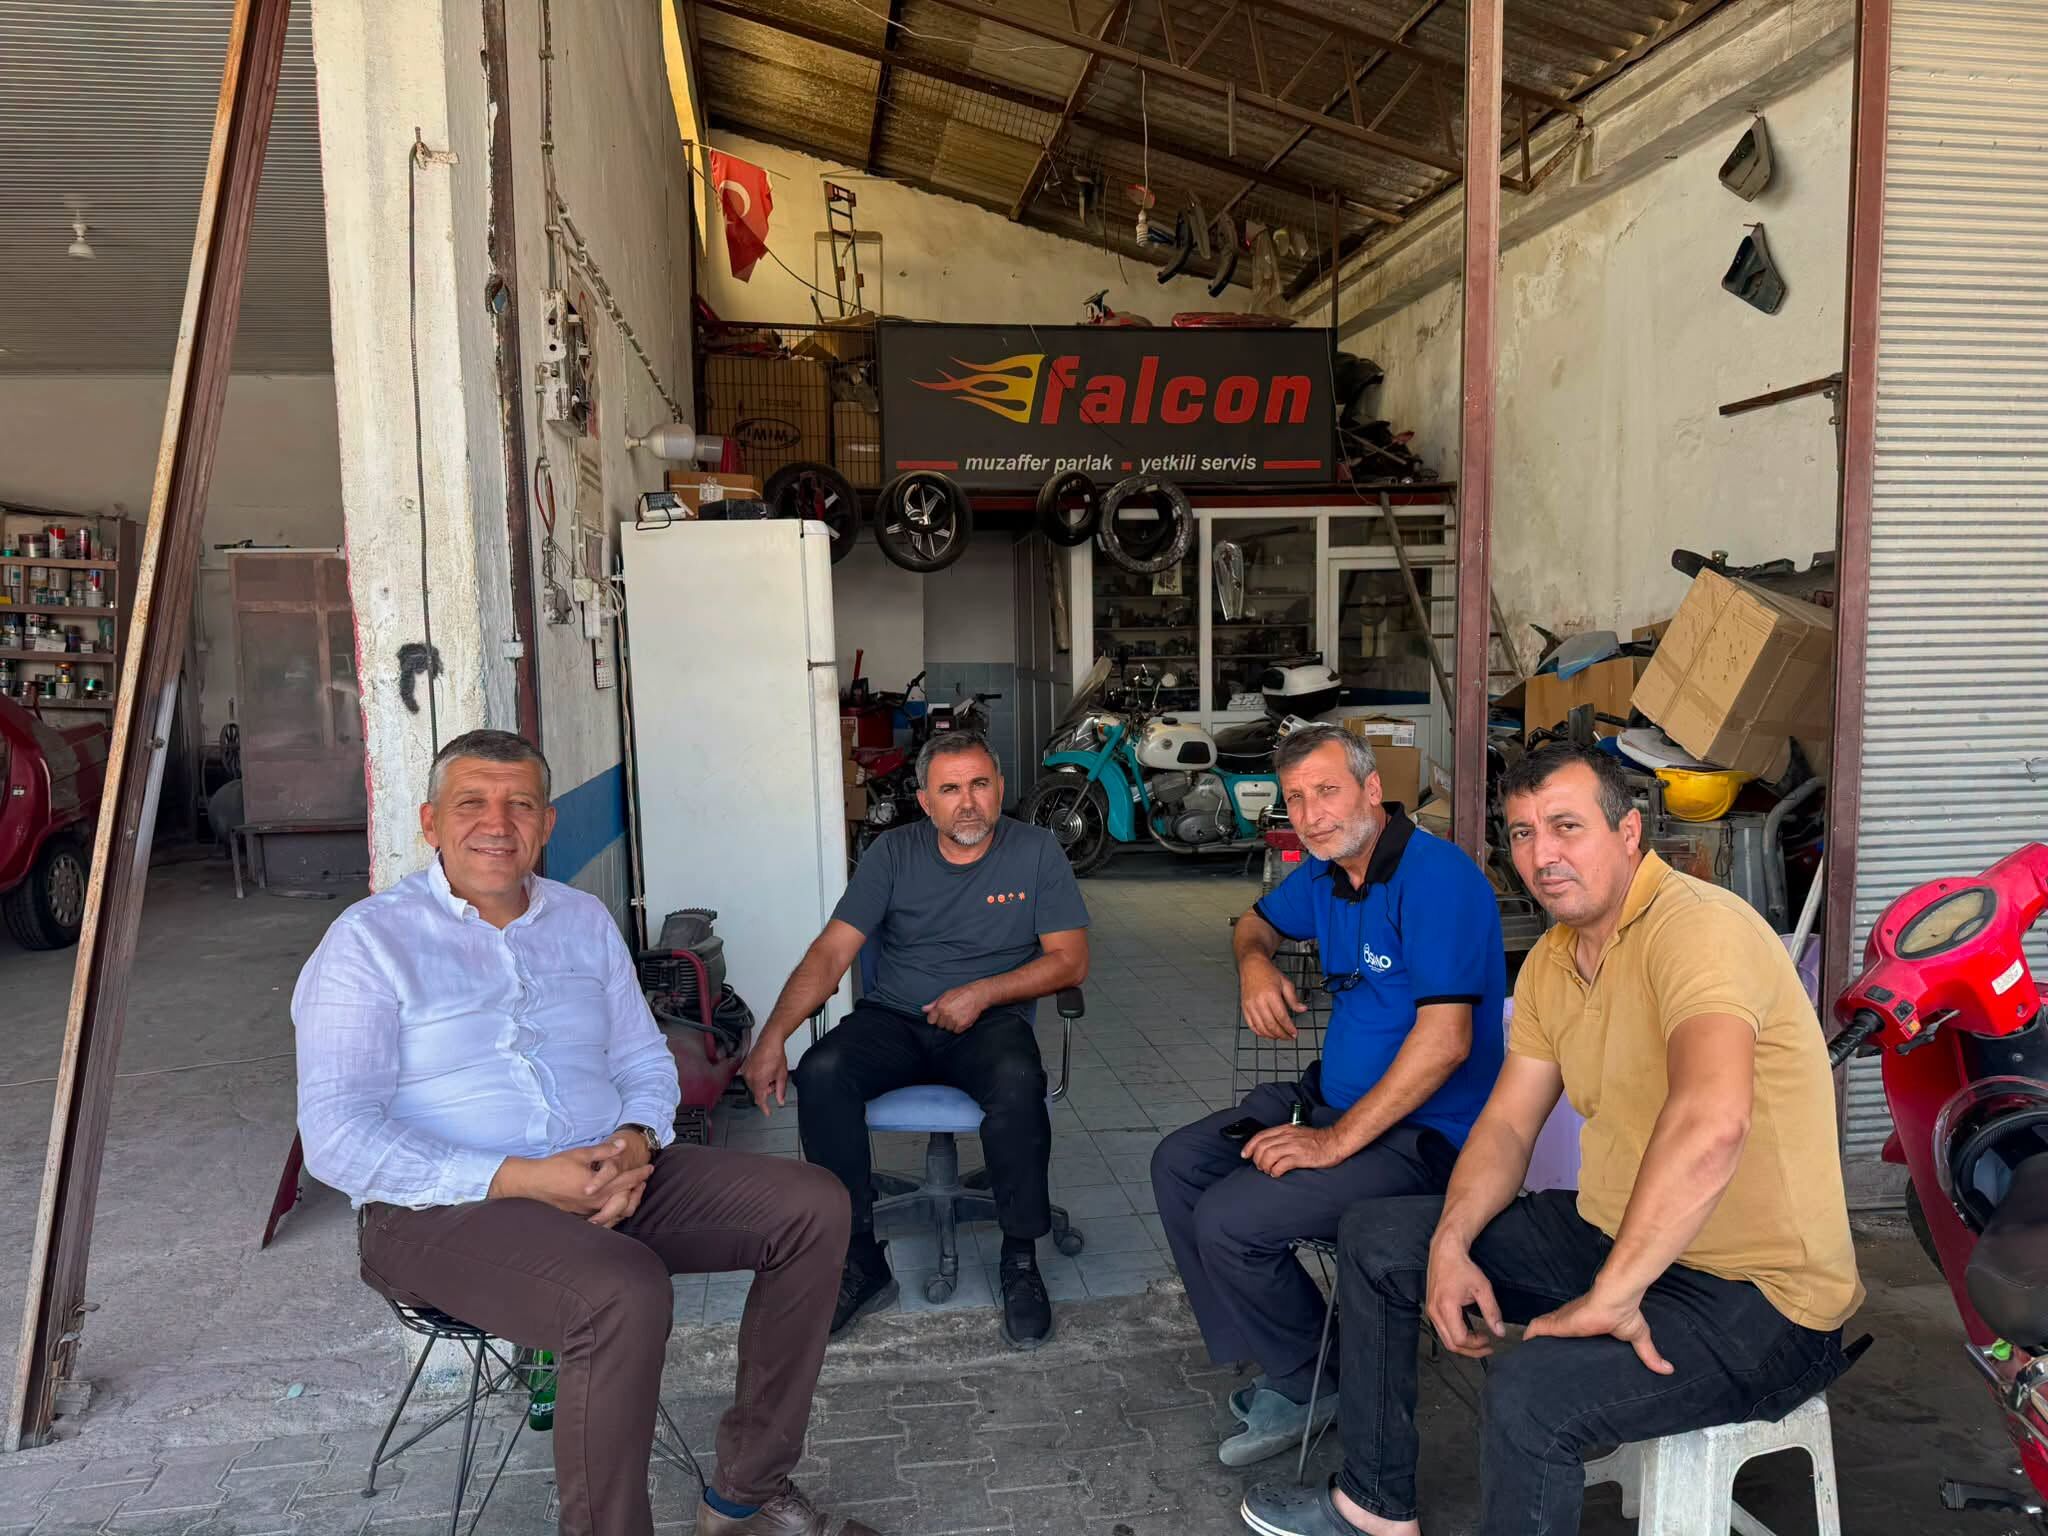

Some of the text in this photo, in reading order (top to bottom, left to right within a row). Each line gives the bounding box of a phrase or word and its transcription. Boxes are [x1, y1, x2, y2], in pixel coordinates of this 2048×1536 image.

[1040, 355, 1312, 424] falcon
[965, 454, 1257, 474] muzaffer parlak yetkili servis
